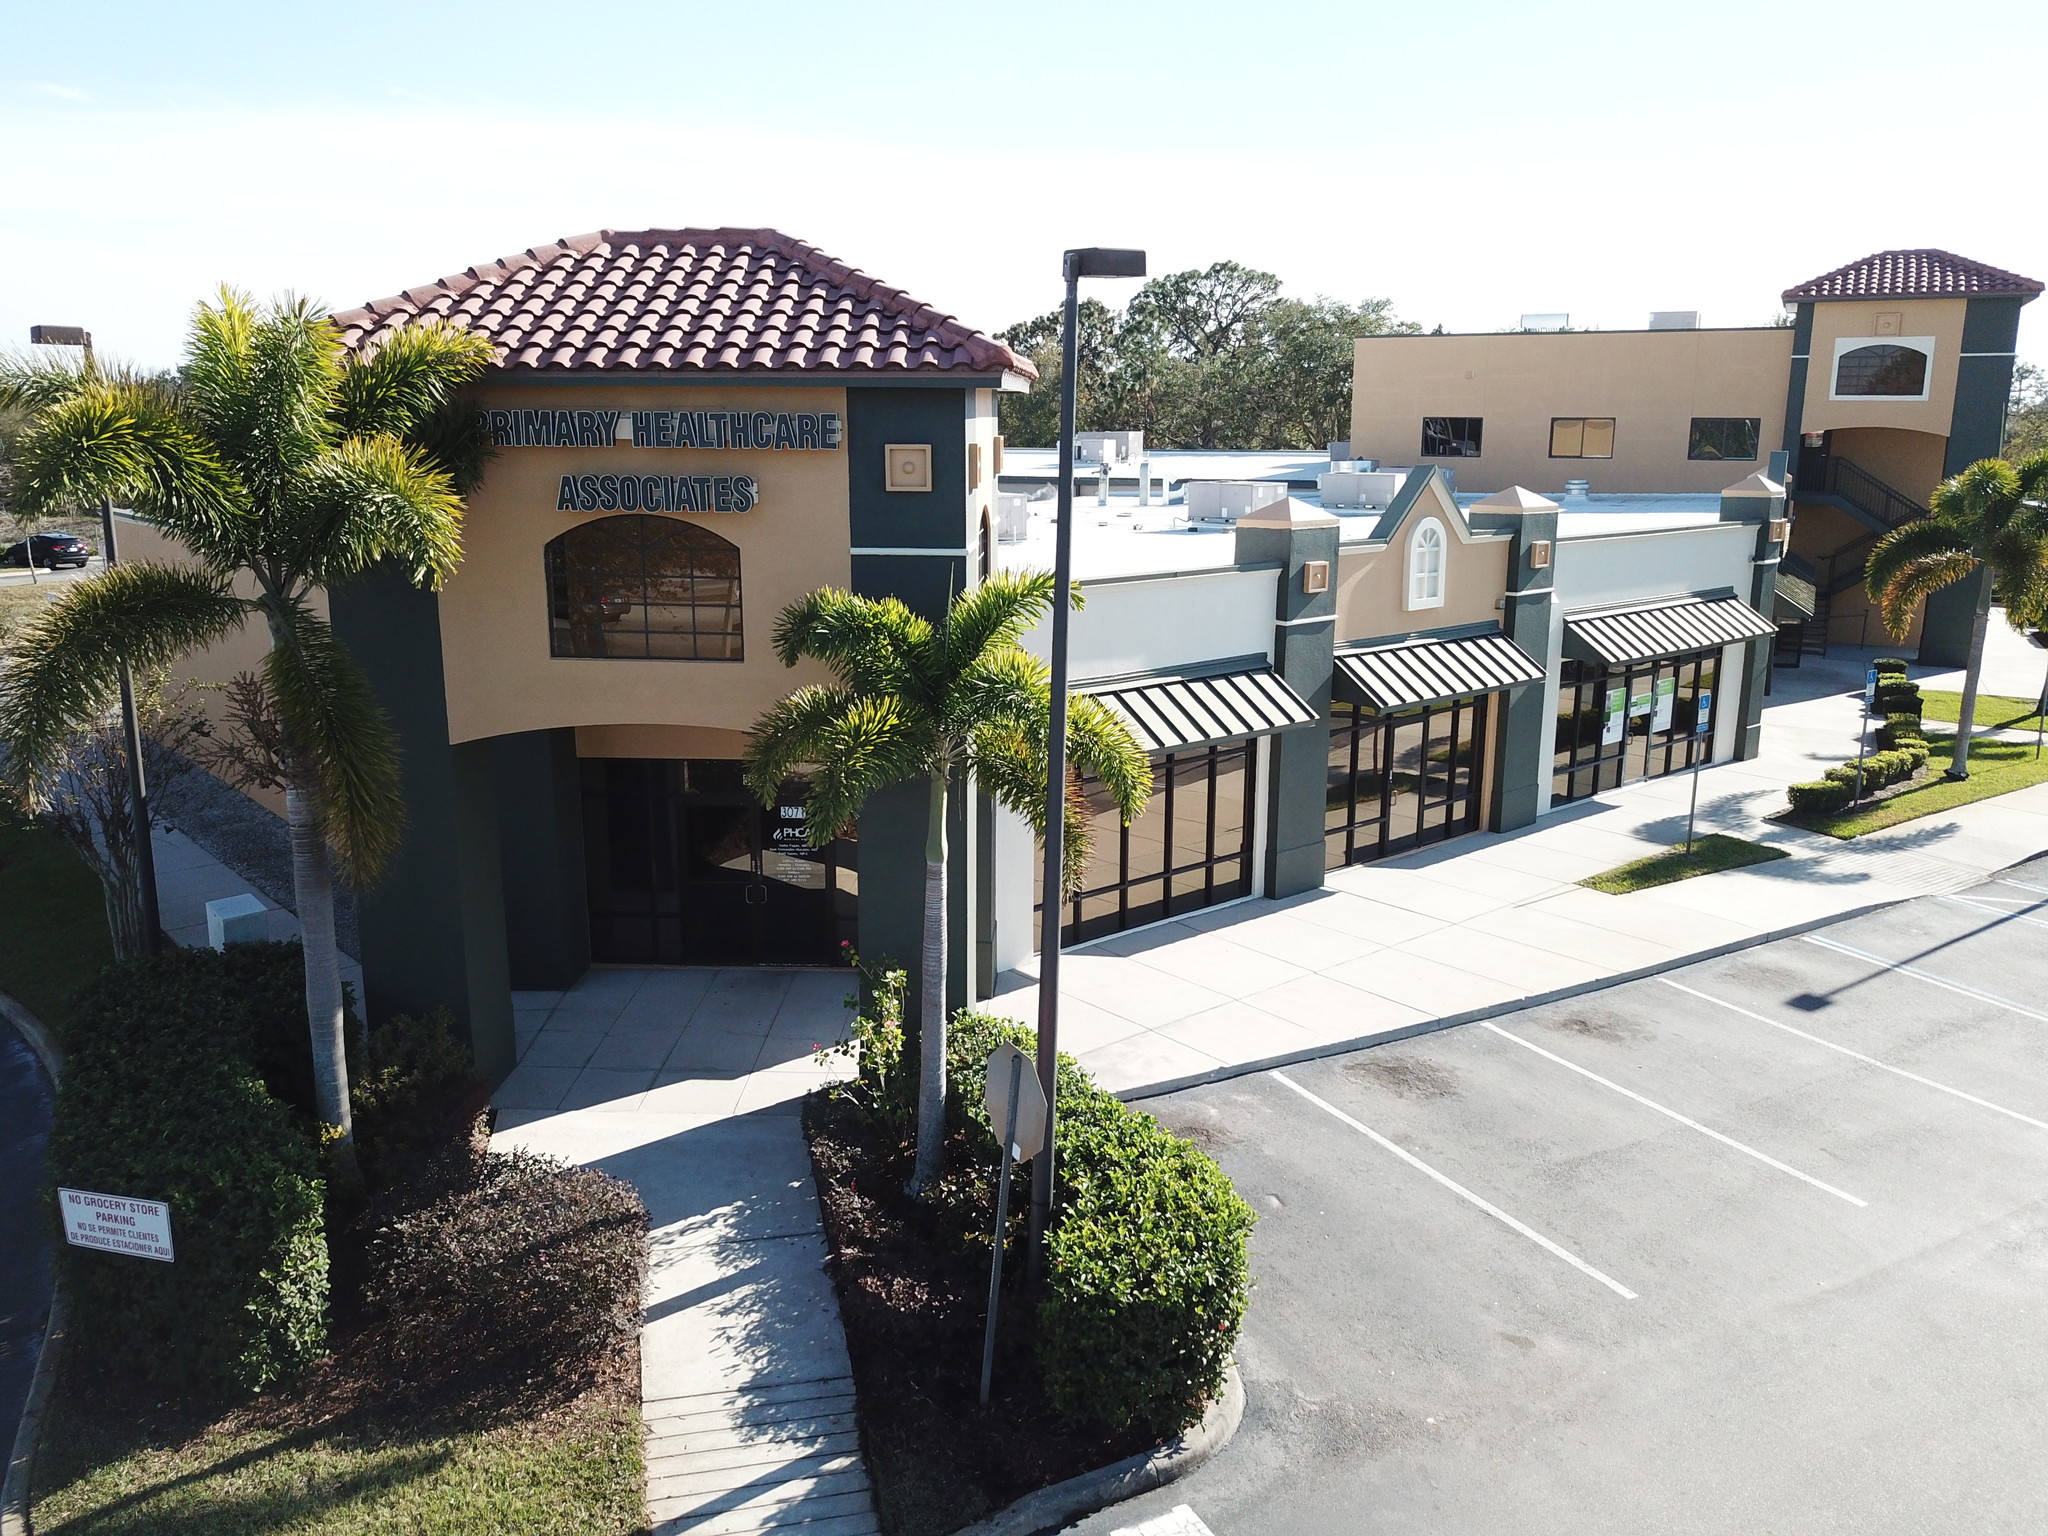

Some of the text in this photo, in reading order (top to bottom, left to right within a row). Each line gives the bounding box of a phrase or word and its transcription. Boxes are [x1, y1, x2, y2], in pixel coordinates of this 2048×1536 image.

[475, 410, 842, 451] PRIMARY HEALTHCARE
[555, 474, 755, 513] ASSOCIATES
[69, 1194, 160, 1216] NO GROCERY STORE
[96, 1212, 136, 1226] PARKING
[70, 1232, 170, 1256] DE PRODUCE ESTACIONER AQUI
[77, 1222, 160, 1243] NO SE PERMITE CLIENTES
